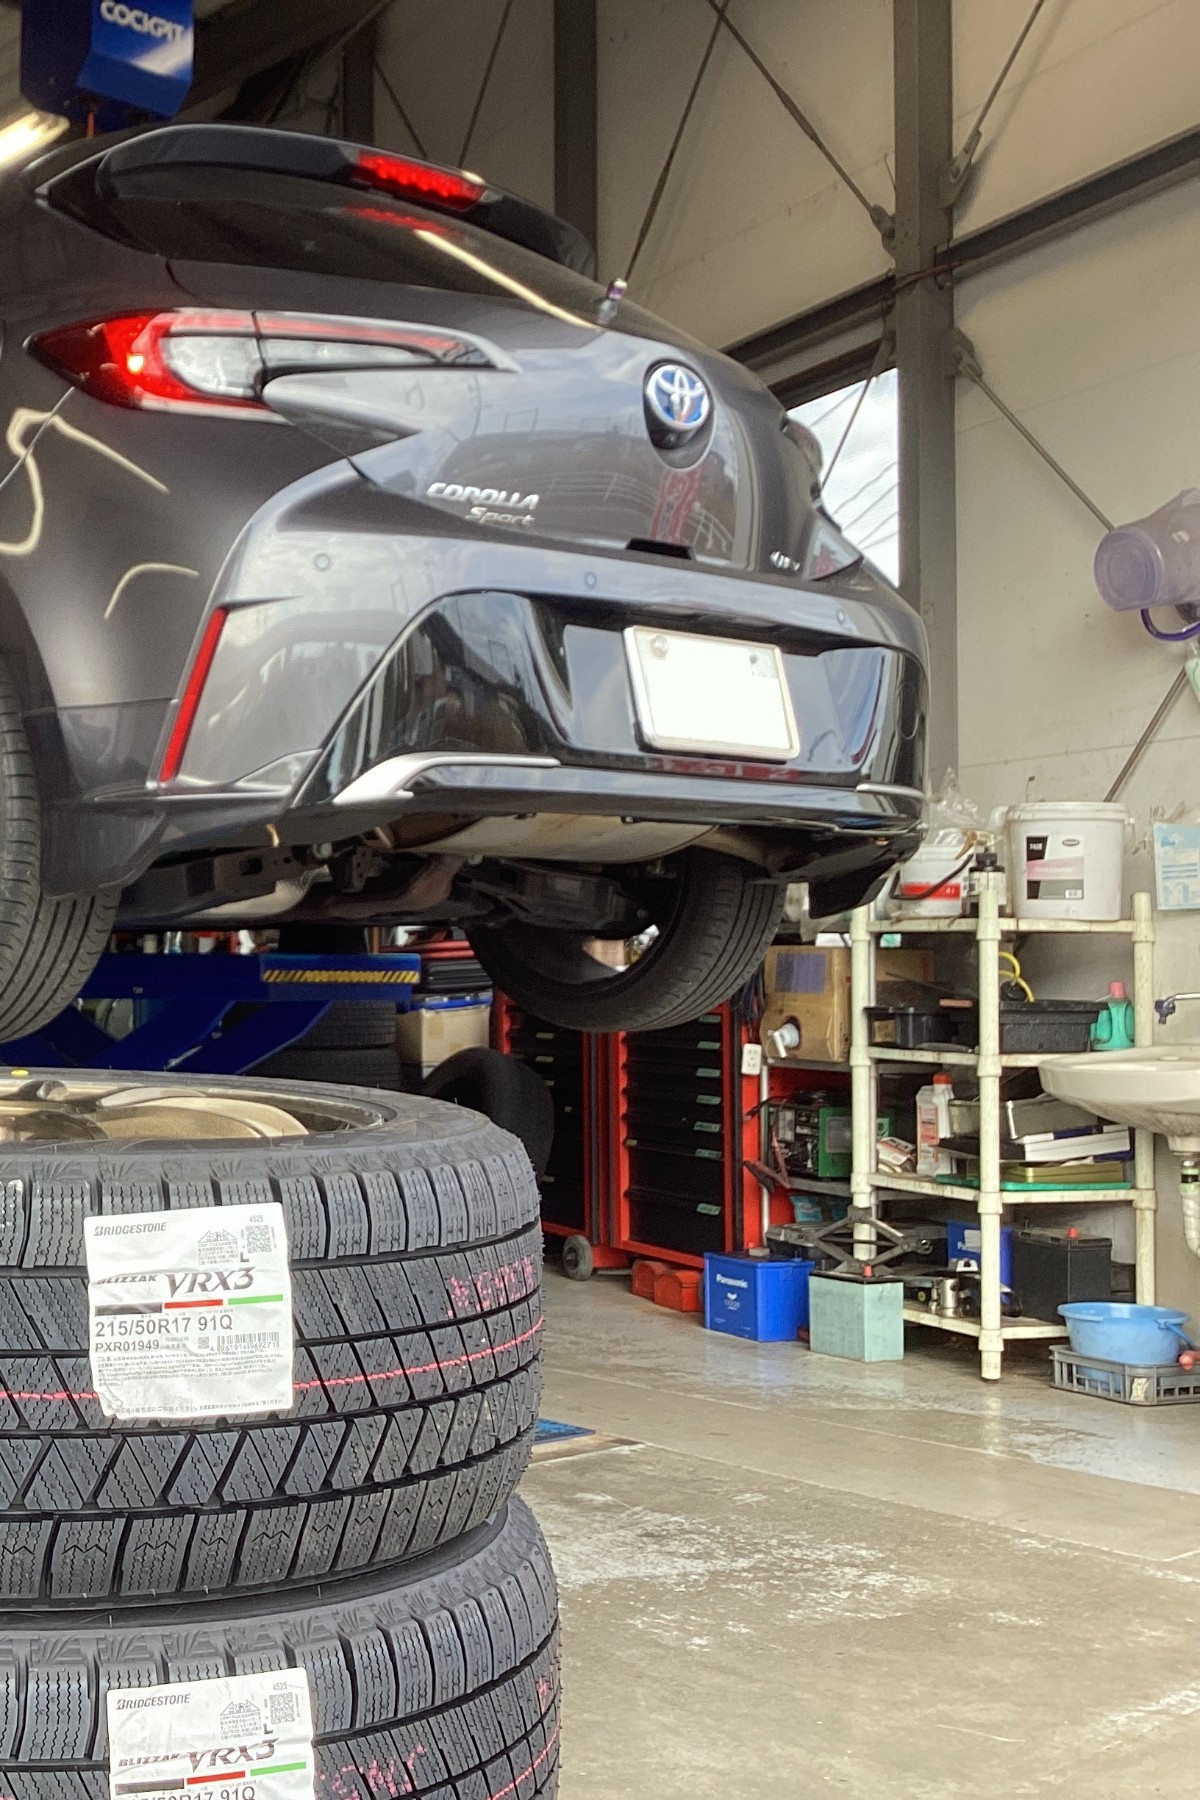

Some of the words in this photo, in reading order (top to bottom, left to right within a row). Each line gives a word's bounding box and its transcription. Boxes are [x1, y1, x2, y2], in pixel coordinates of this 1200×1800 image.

[426, 482, 540, 510] COROLLA
[465, 506, 535, 525] Sport
[249, 1214, 264, 1223] 4525
[94, 1221, 167, 1237] BRIDGESTONE
[164, 1266, 256, 1298] VRX3
[95, 1317, 192, 1337] 215/50R17
[198, 1314, 234, 1331] 91Q
[94, 1339, 160, 1353] PXR01949
[272, 1681, 288, 1691] 4525
[116, 1693, 191, 1710] BRIDGESTONE
[118, 1753, 182, 1767] BLIZZAK
[186, 1738, 279, 1774] VRX3
